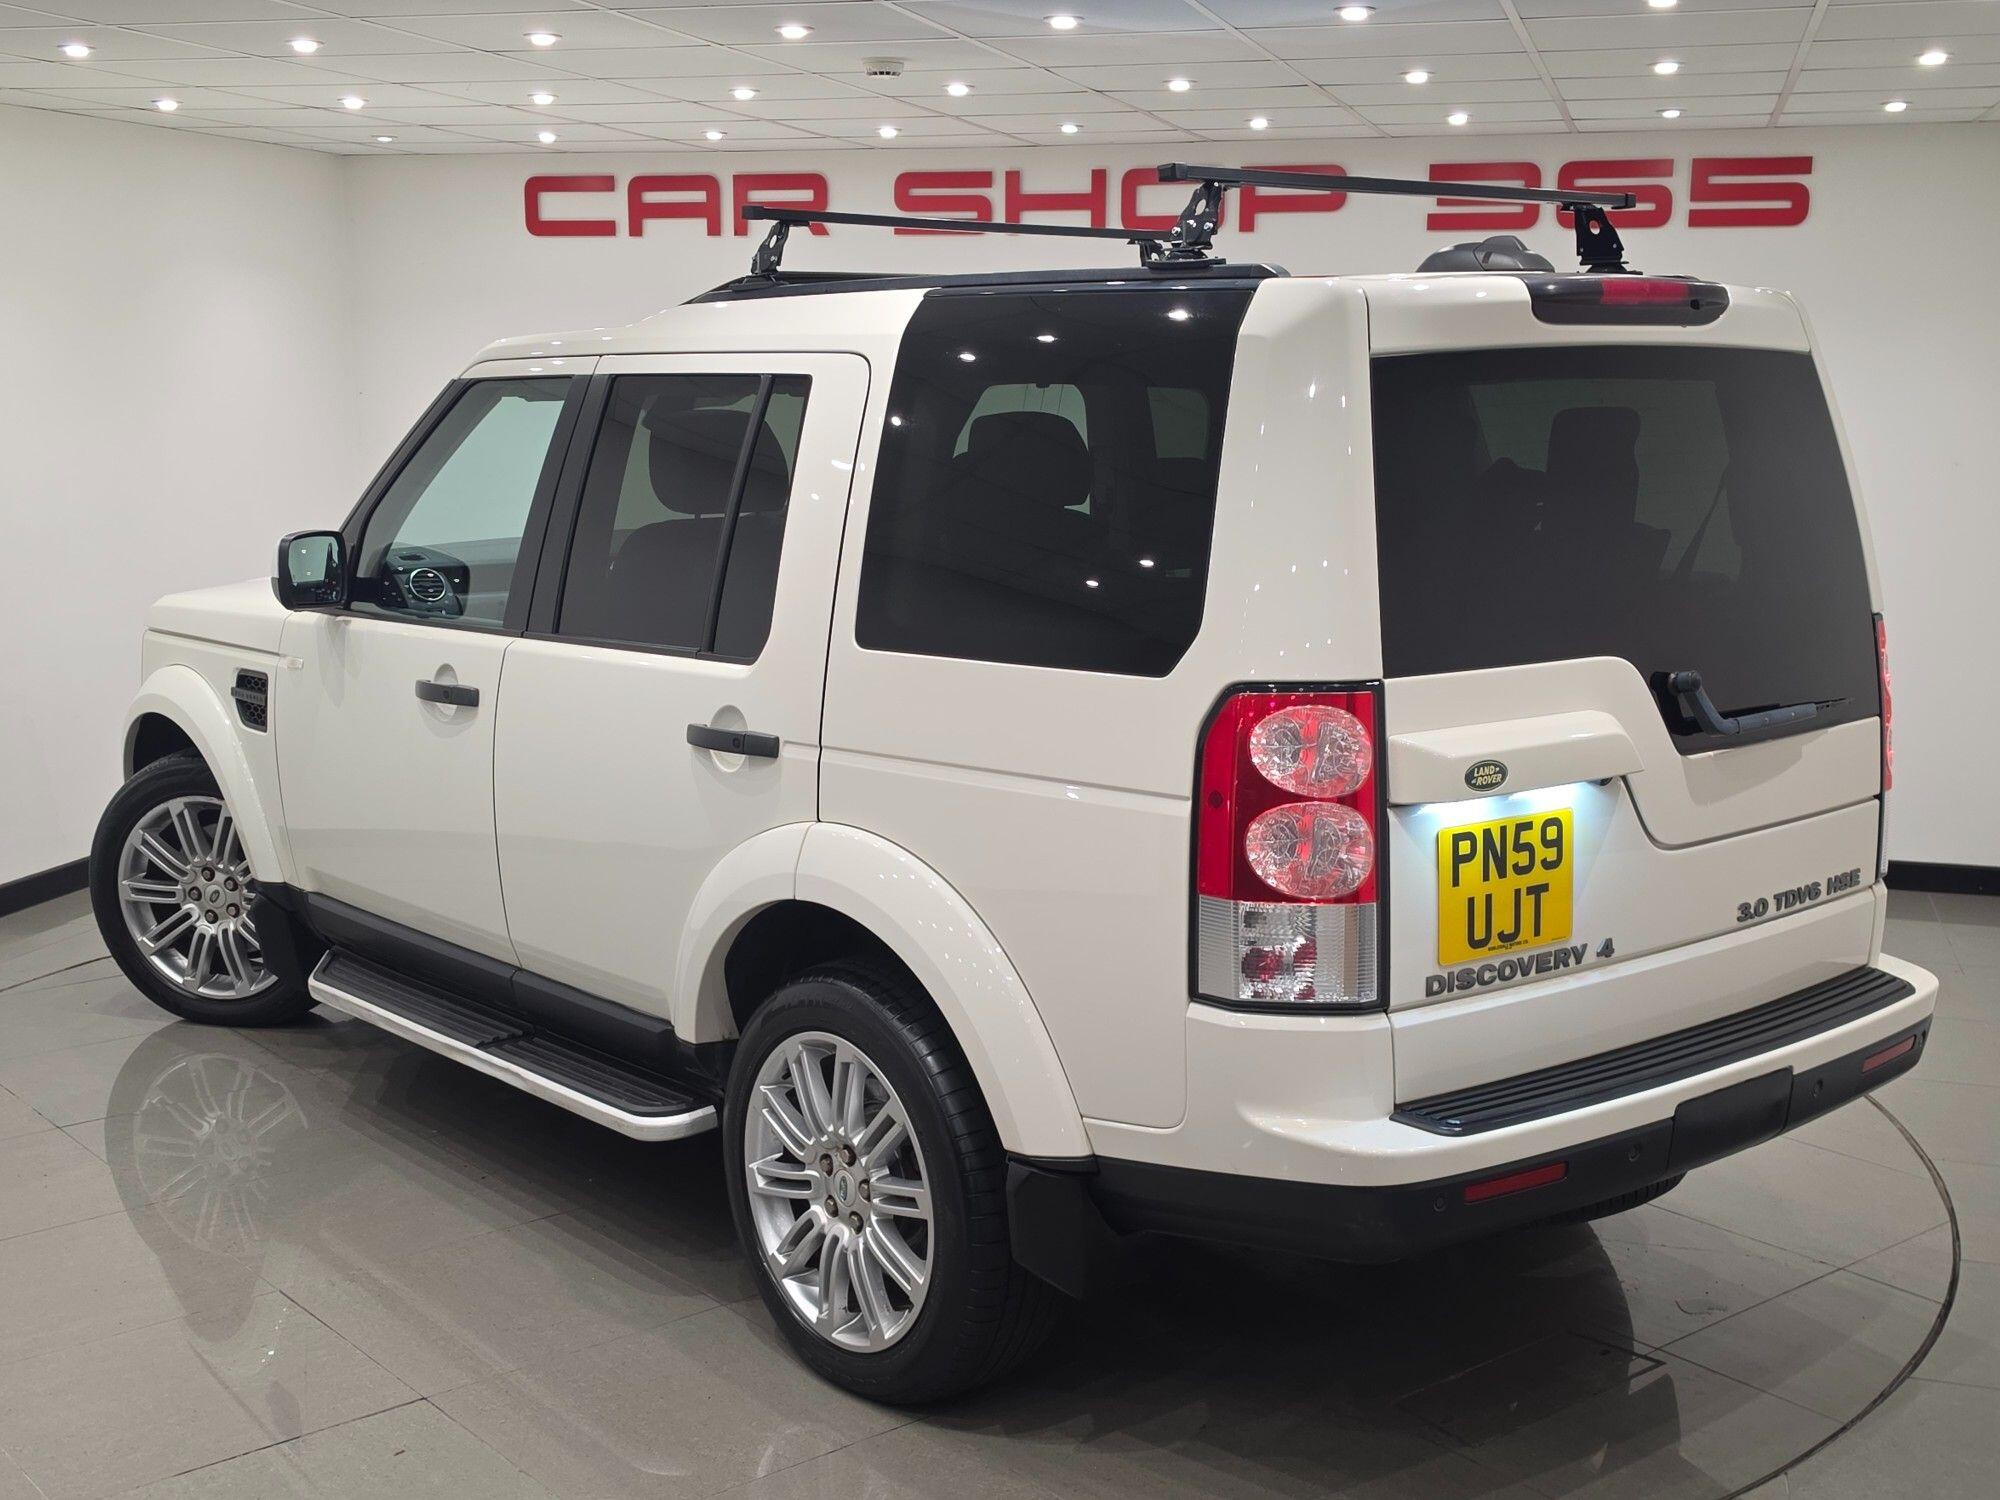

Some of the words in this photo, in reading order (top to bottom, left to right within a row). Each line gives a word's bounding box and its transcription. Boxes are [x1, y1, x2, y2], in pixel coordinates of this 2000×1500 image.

[524, 172, 829, 238] CAR
[893, 162, 1346, 238] SHOP
[1427, 154, 1812, 230] 365
[1474, 765, 1495, 777] LAND
[1476, 773, 1503, 786] ROVER
[1451, 816, 1564, 888] PN59
[1466, 882, 1550, 950] UJT
[1773, 881, 1822, 912] TDV6
[1826, 867, 1862, 896] HSE
[1425, 942, 1588, 998] DISCOVERY
[1596, 937, 1616, 959] 4
